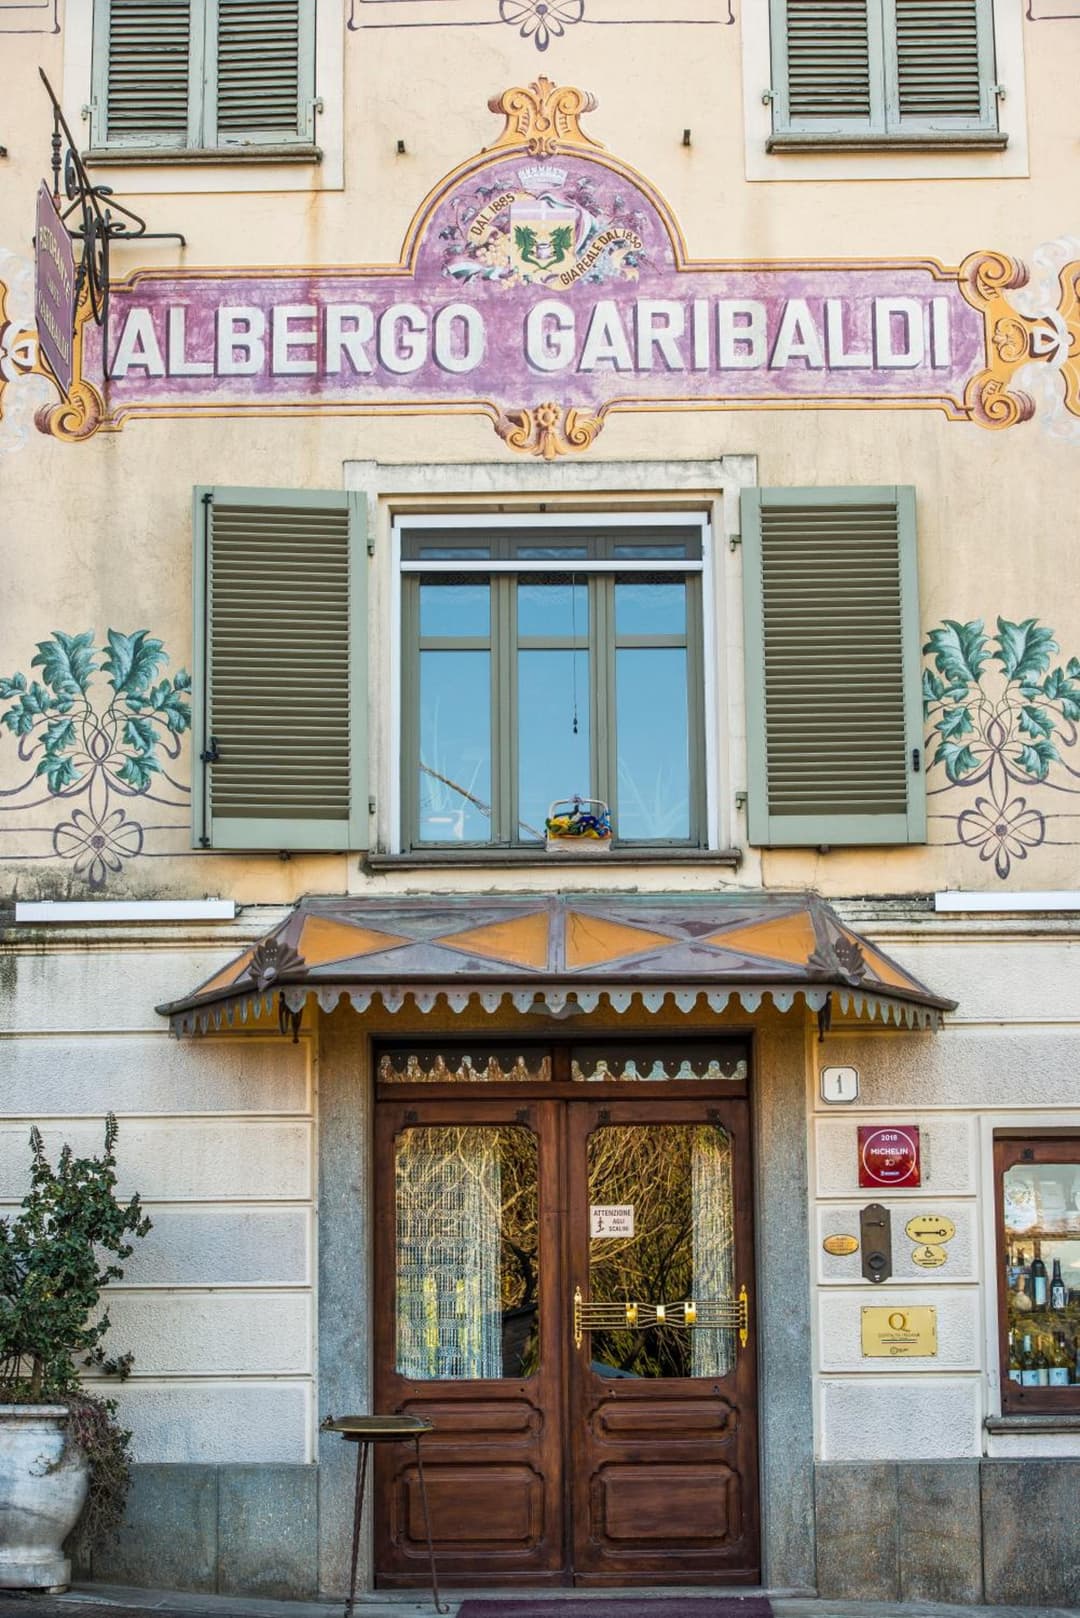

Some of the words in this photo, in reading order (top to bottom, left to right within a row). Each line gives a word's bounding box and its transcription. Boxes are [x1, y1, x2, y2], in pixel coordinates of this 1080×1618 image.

[471, 214, 490, 236] DAL
[488, 193, 515, 214] 1885
[576, 242, 602, 274] REALE
[598, 229, 620, 245] DAL
[110, 303, 485, 378] ALBERGO
[524, 297, 951, 374] GARIBALDI
[836, 1072, 843, 1094] 1
[870, 1147, 908, 1155] MICHELIN
[888, 1312, 911, 1332] Q
